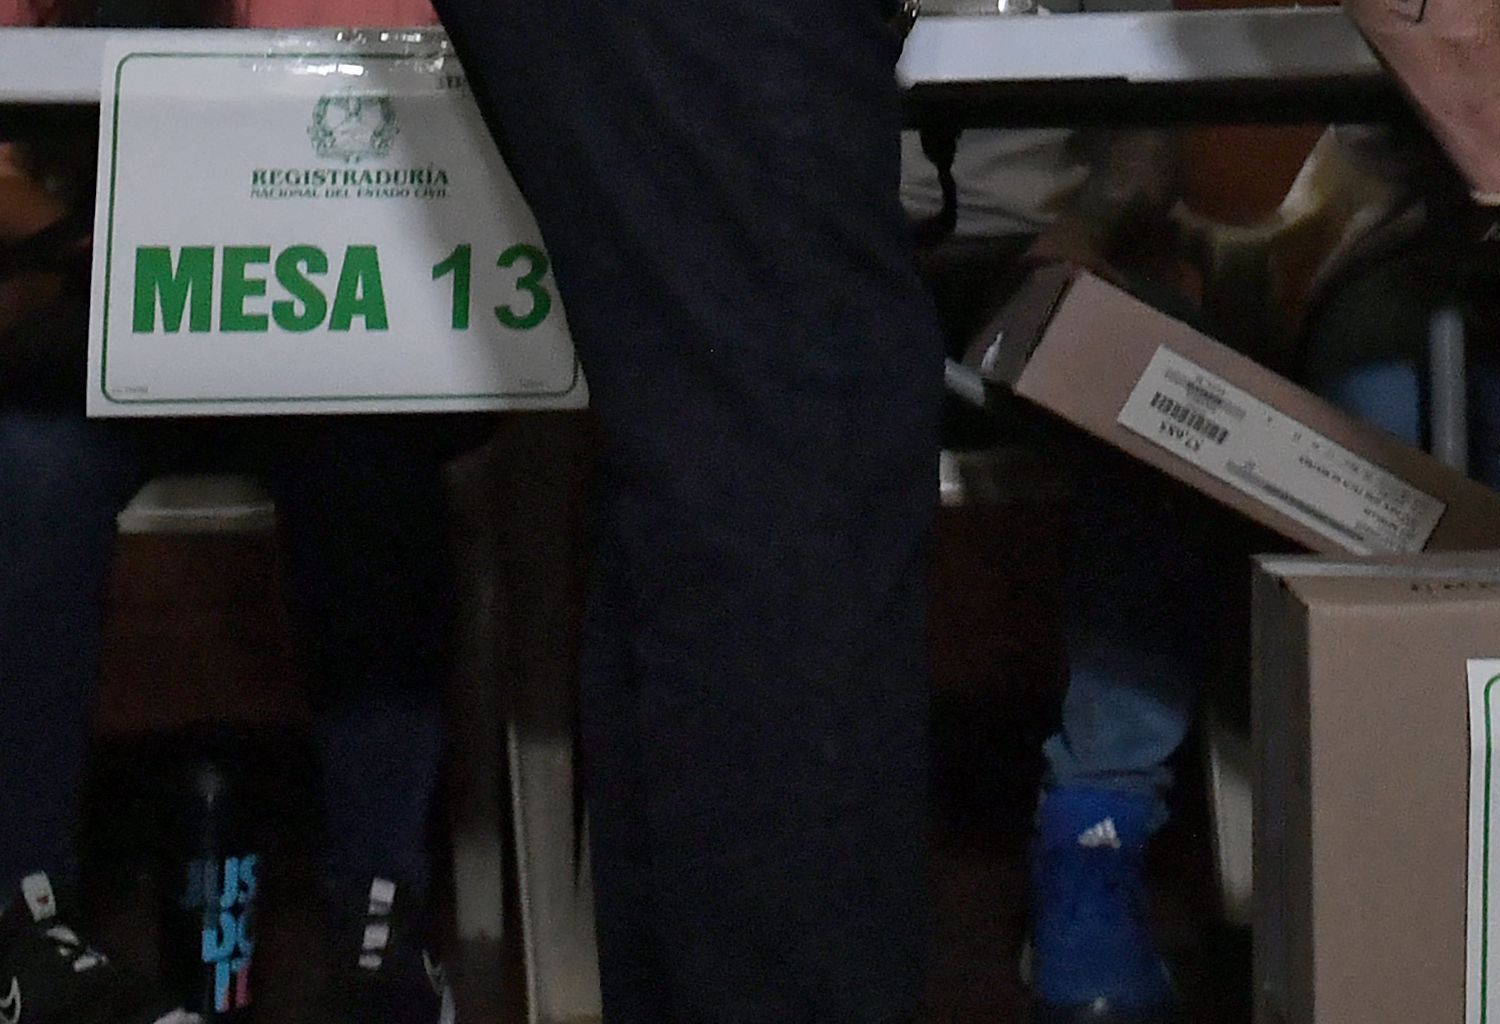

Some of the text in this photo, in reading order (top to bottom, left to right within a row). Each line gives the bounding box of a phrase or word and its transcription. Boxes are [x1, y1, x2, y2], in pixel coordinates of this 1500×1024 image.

[251, 161, 450, 186] REGISTRADURÍA
[132, 242, 552, 333] MESA 13
